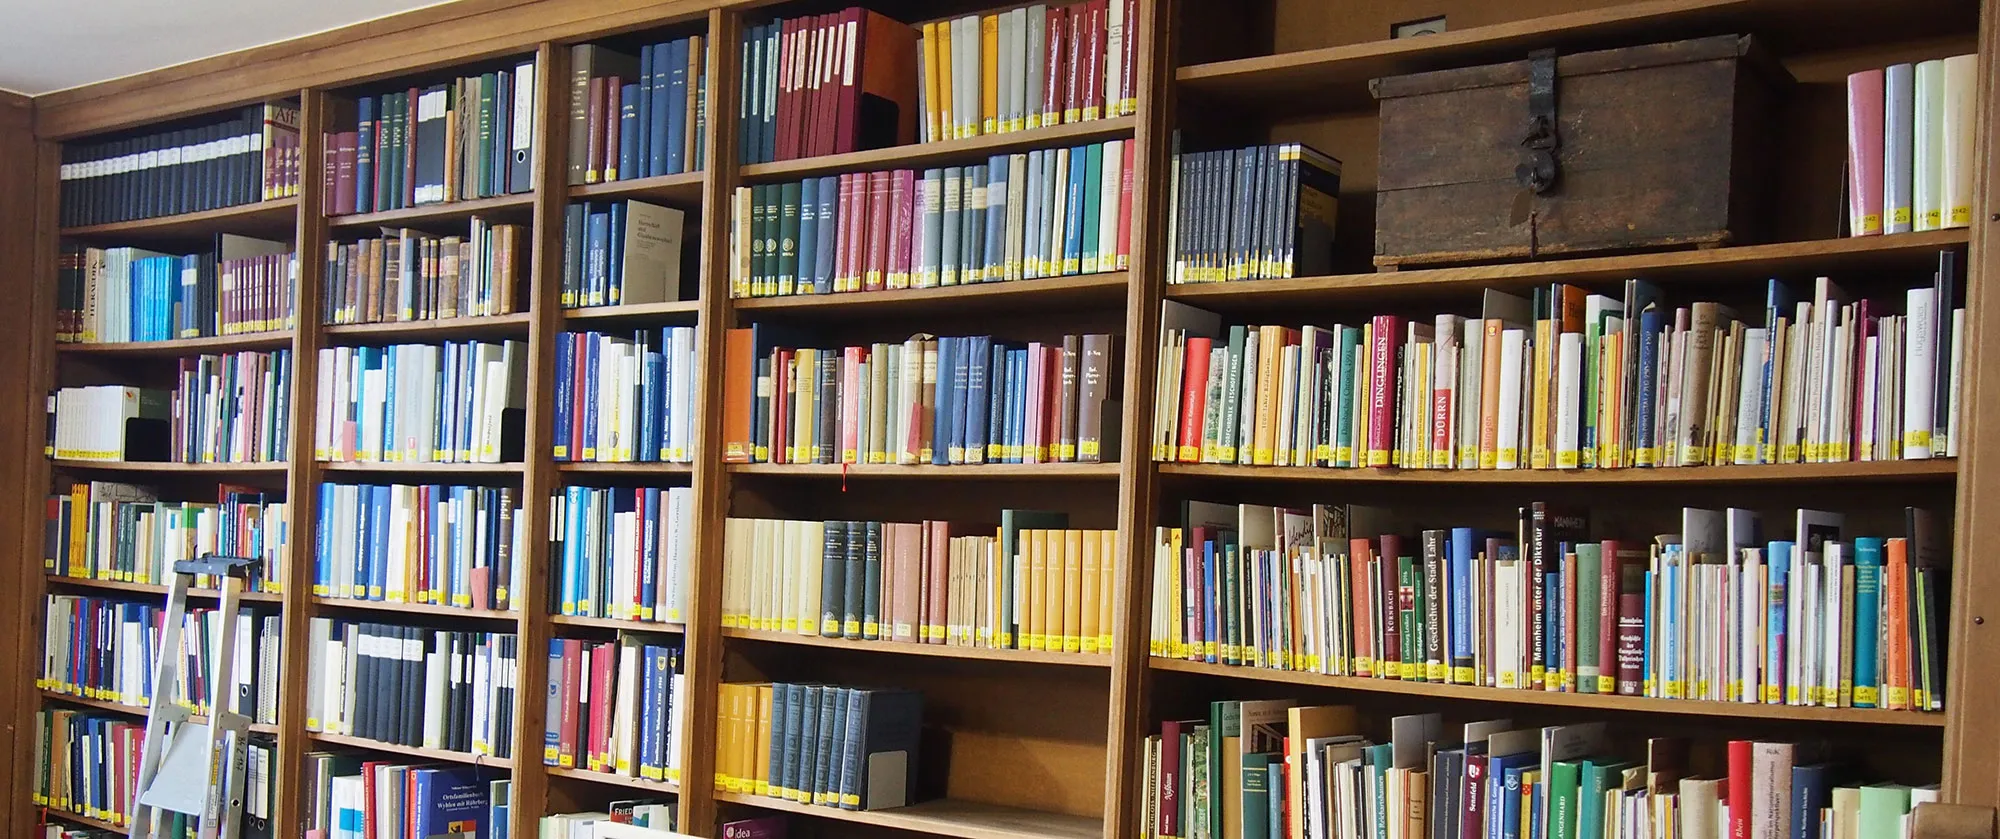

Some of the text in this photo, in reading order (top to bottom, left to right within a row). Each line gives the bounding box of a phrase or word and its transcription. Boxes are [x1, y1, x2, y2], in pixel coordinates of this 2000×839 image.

[275, 107, 297, 124] AfF
[1375, 337, 1386, 409] DINGLINGEN
[1225, 354, 1238, 447] DORFCHRONIK BISCHOFFINGEN
[1435, 396, 1447, 437] DÜRRN
[1427, 537, 1439, 652] Geschichte der Stadt Lahr
[1533, 527, 1543, 661] Mannheim unter der Diktatur
[614, 807, 633, 816] FRIED
[1378, 775, 1386, 828] Reichartshausen
[1468, 782, 1477, 812] Sennfeld
[1558, 796, 1566, 839] ANGENHARD
[735, 828, 751, 838] idea
